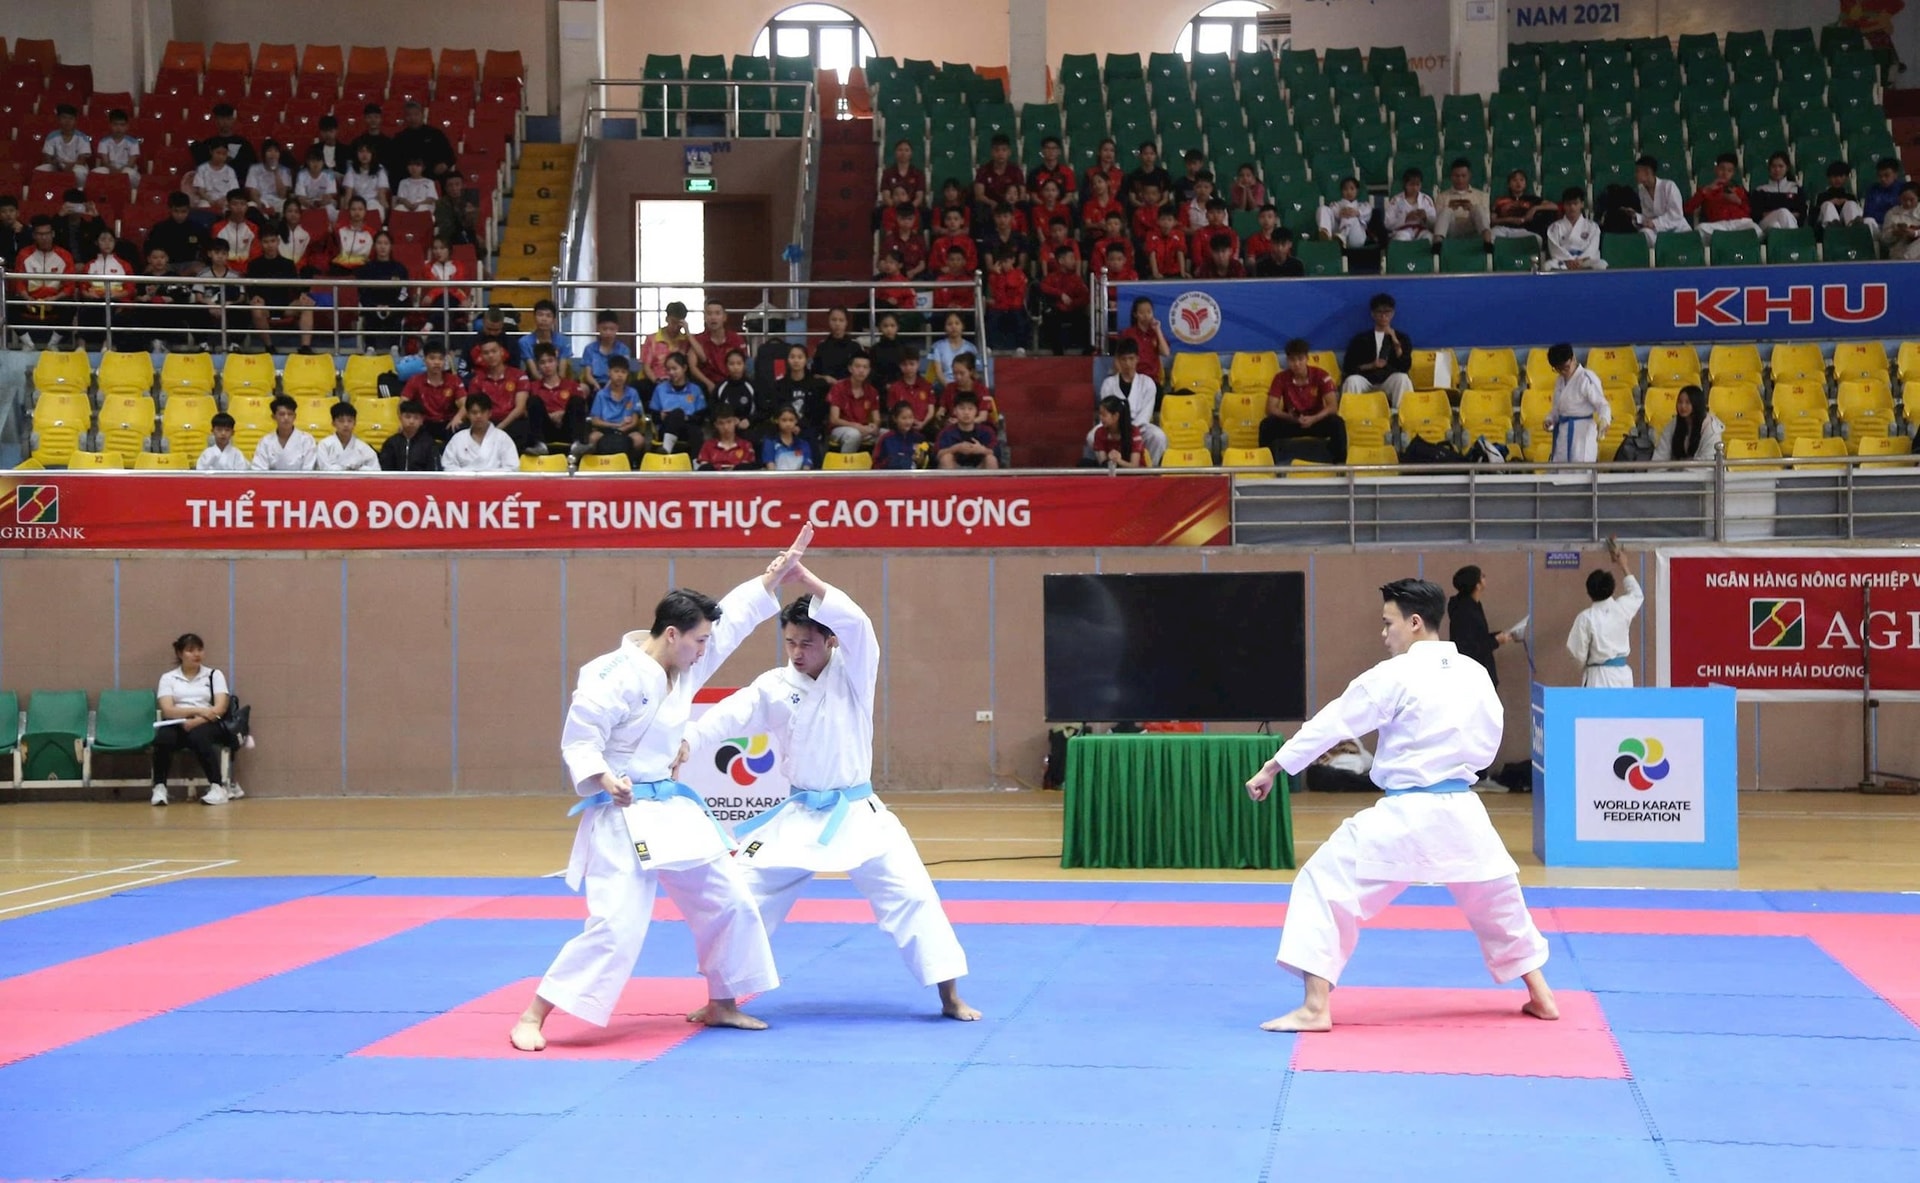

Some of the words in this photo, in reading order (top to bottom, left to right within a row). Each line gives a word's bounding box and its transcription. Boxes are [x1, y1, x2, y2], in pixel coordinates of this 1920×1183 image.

[1516, 7, 1567, 26] NAM
[1574, 4, 1620, 24] 2021
[529, 214, 540, 226] E
[523, 243, 537, 256] D
[1674, 283, 1888, 327] KHU
[186, 490, 255, 528] THỂ
[261, 500, 359, 529] THAO
[367, 495, 469, 529] ĐOÀN
[479, 492, 541, 529] KẾT
[566, 500, 682, 529] TRUNG
[689, 496, 782, 536] THỰC
[808, 500, 879, 528] CAO
[885, 495, 1031, 534] THƯỢNG
[0, 527, 85, 540] GRIBANK
[1706, 572, 1749, 588] NGÂN
[1753, 571, 1798, 588] HÀNG
[1801, 571, 1846, 588] NÔNG
[1850, 570, 1909, 591] NGHIỆP
[1697, 665, 1721, 677] CHI
[1725, 663, 1778, 677] NHÁNH
[1782, 662, 1808, 677] HẢI
[704, 797, 743, 808] ORLD
[1593, 800, 1640, 810] WORLD
[1642, 800, 1691, 810] KARATE
[1603, 812, 1680, 822] FEDERATION
